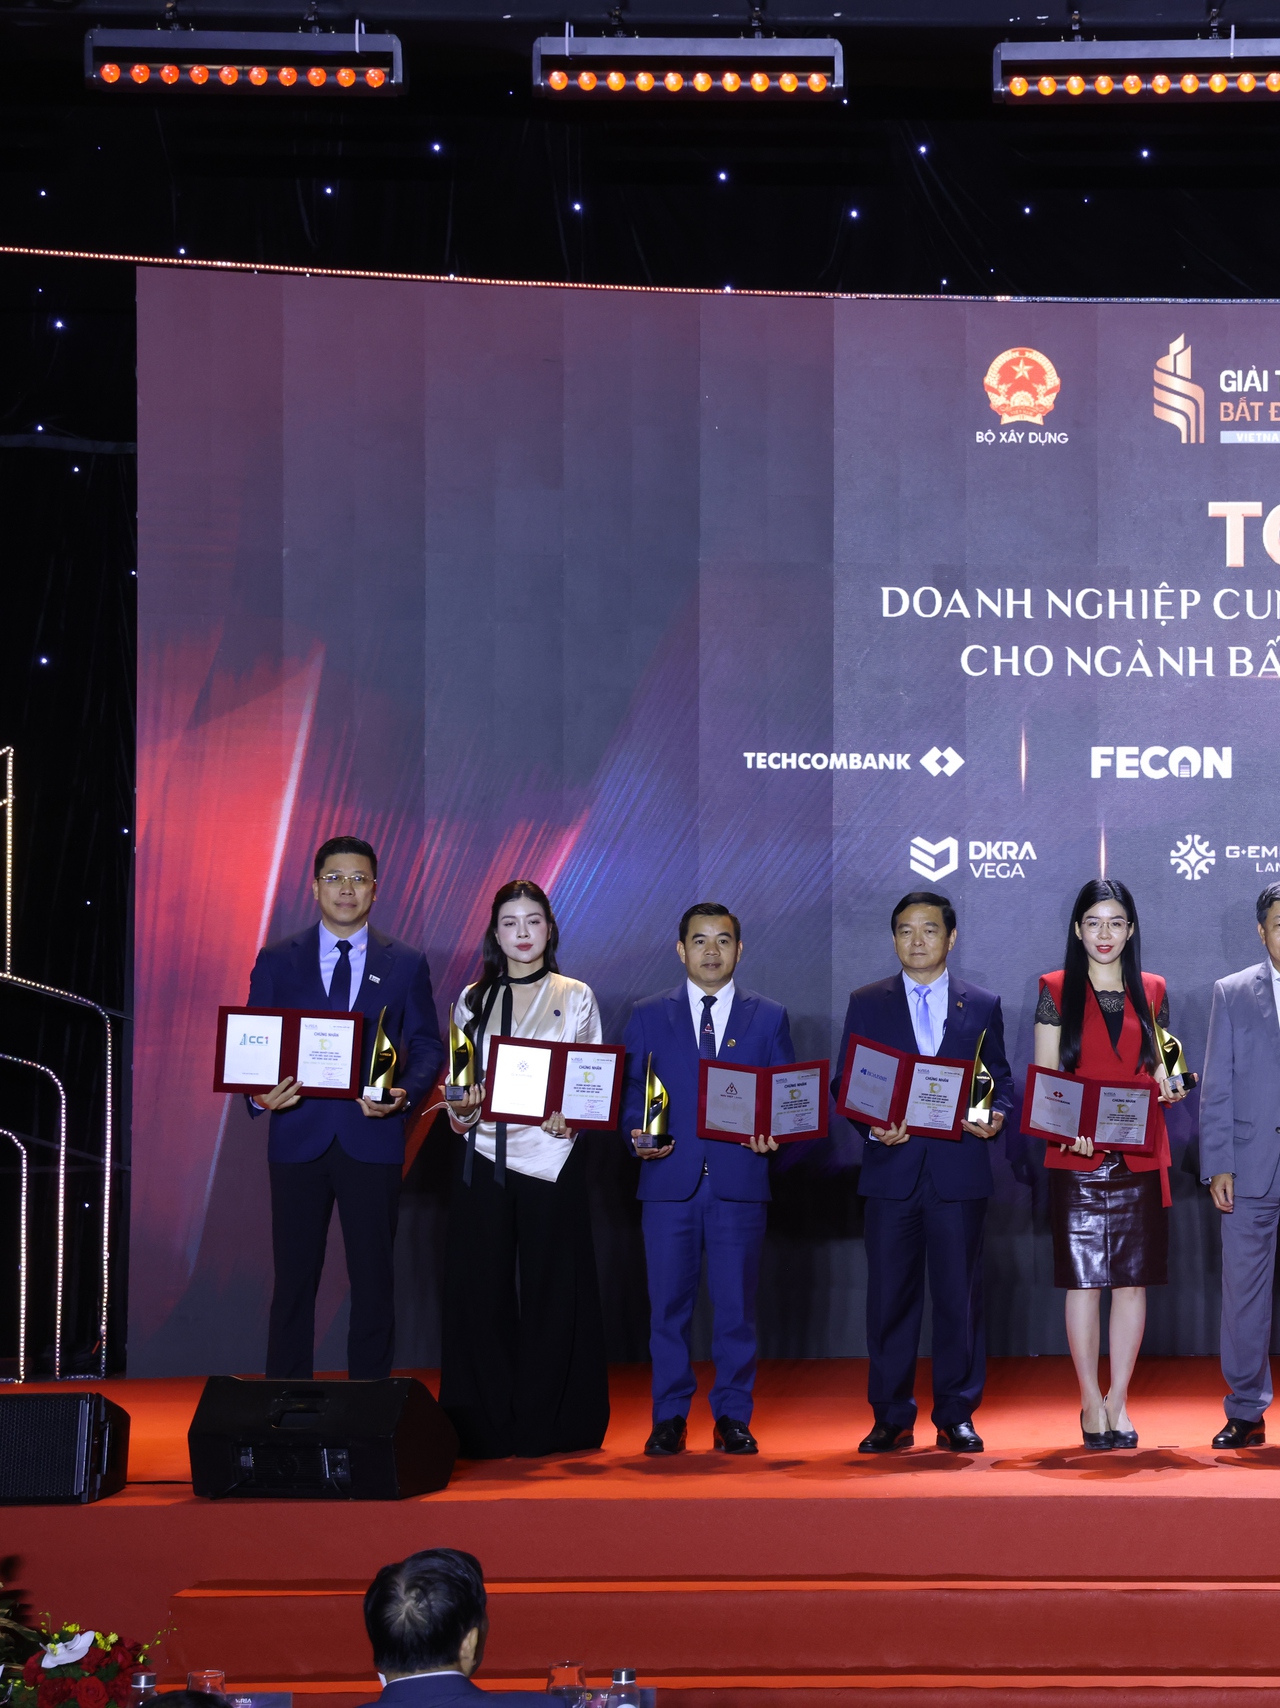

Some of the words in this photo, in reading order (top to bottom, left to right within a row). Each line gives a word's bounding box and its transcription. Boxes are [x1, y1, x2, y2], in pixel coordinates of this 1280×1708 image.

[1219, 364, 1269, 393] GIẢI
[1219, 396, 1264, 422] BẤT
[975, 428, 996, 446] BỘ
[999, 429, 1025, 444] XÂY
[1028, 431, 1069, 446] DỰNG
[881, 586, 1034, 620] DOANH
[1046, 581, 1201, 627] NGHIỆP
[960, 644, 1054, 677] CHO
[1065, 638, 1216, 678] NGÀNH
[743, 752, 912, 770] TECHCOMBANK
[1090, 745, 1233, 780] FECON
[968, 840, 1038, 860] DKRA
[968, 862, 1026, 879] VEGA
